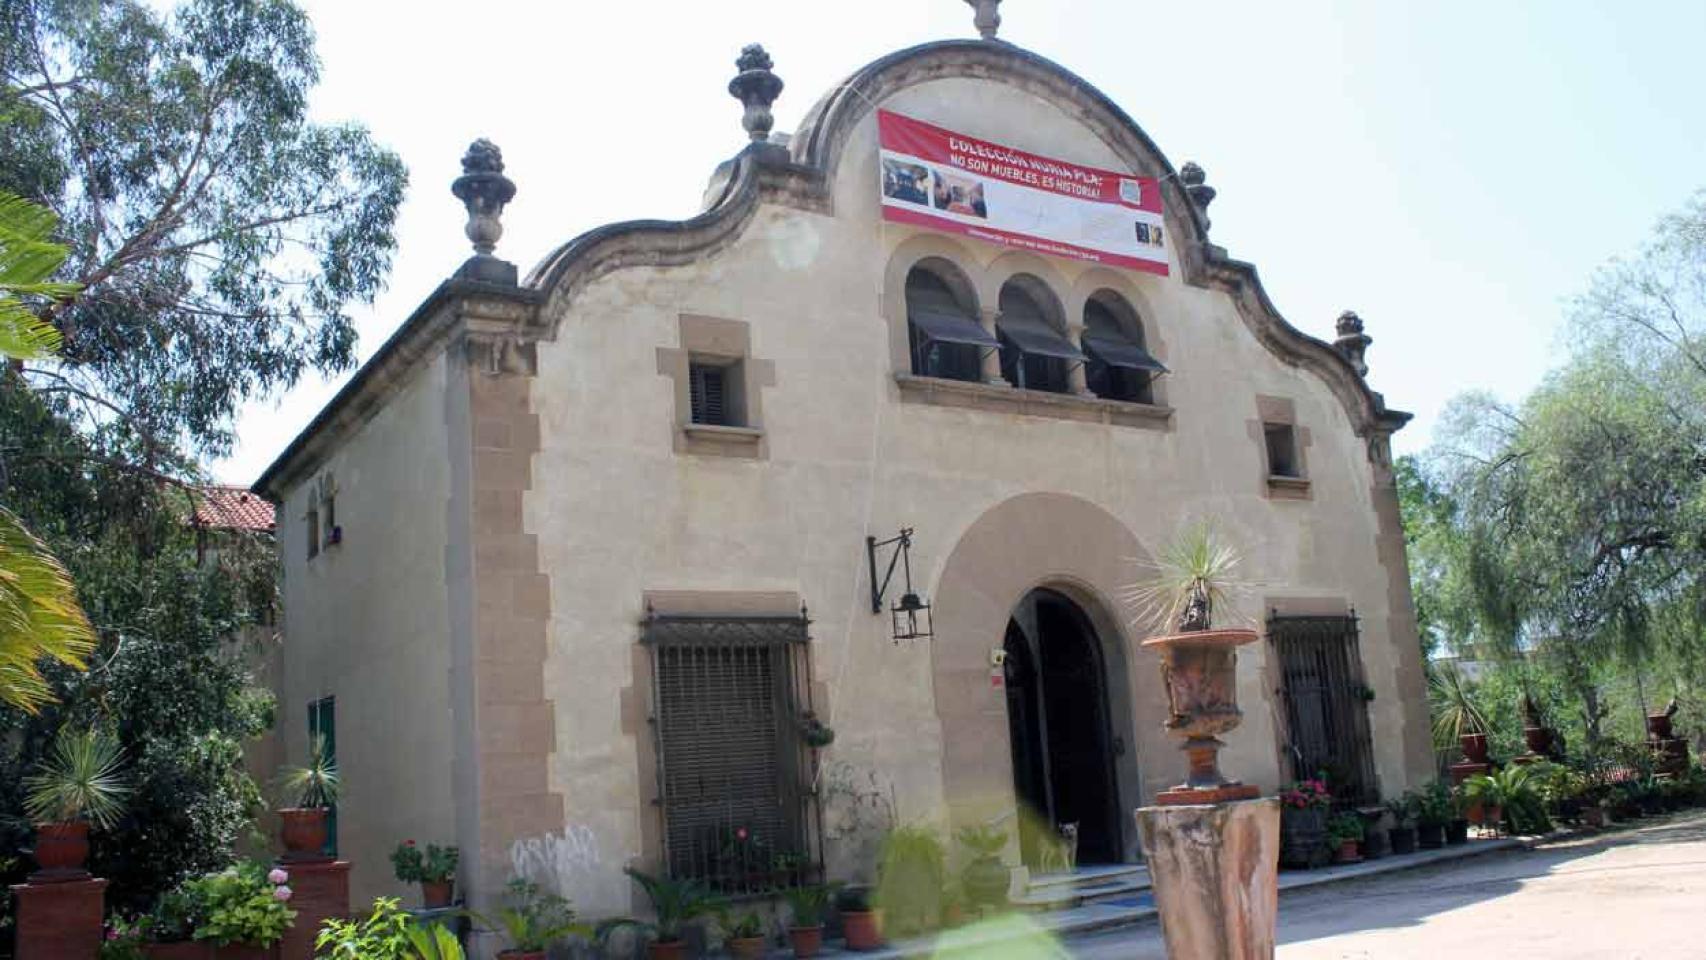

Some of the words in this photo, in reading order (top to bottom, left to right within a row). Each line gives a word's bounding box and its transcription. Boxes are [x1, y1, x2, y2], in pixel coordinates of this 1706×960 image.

[950, 153, 966, 167] NO
[967, 158, 989, 174] SON
[991, 164, 1040, 187] MUEBLES,
[1042, 174, 1055, 189] ES
